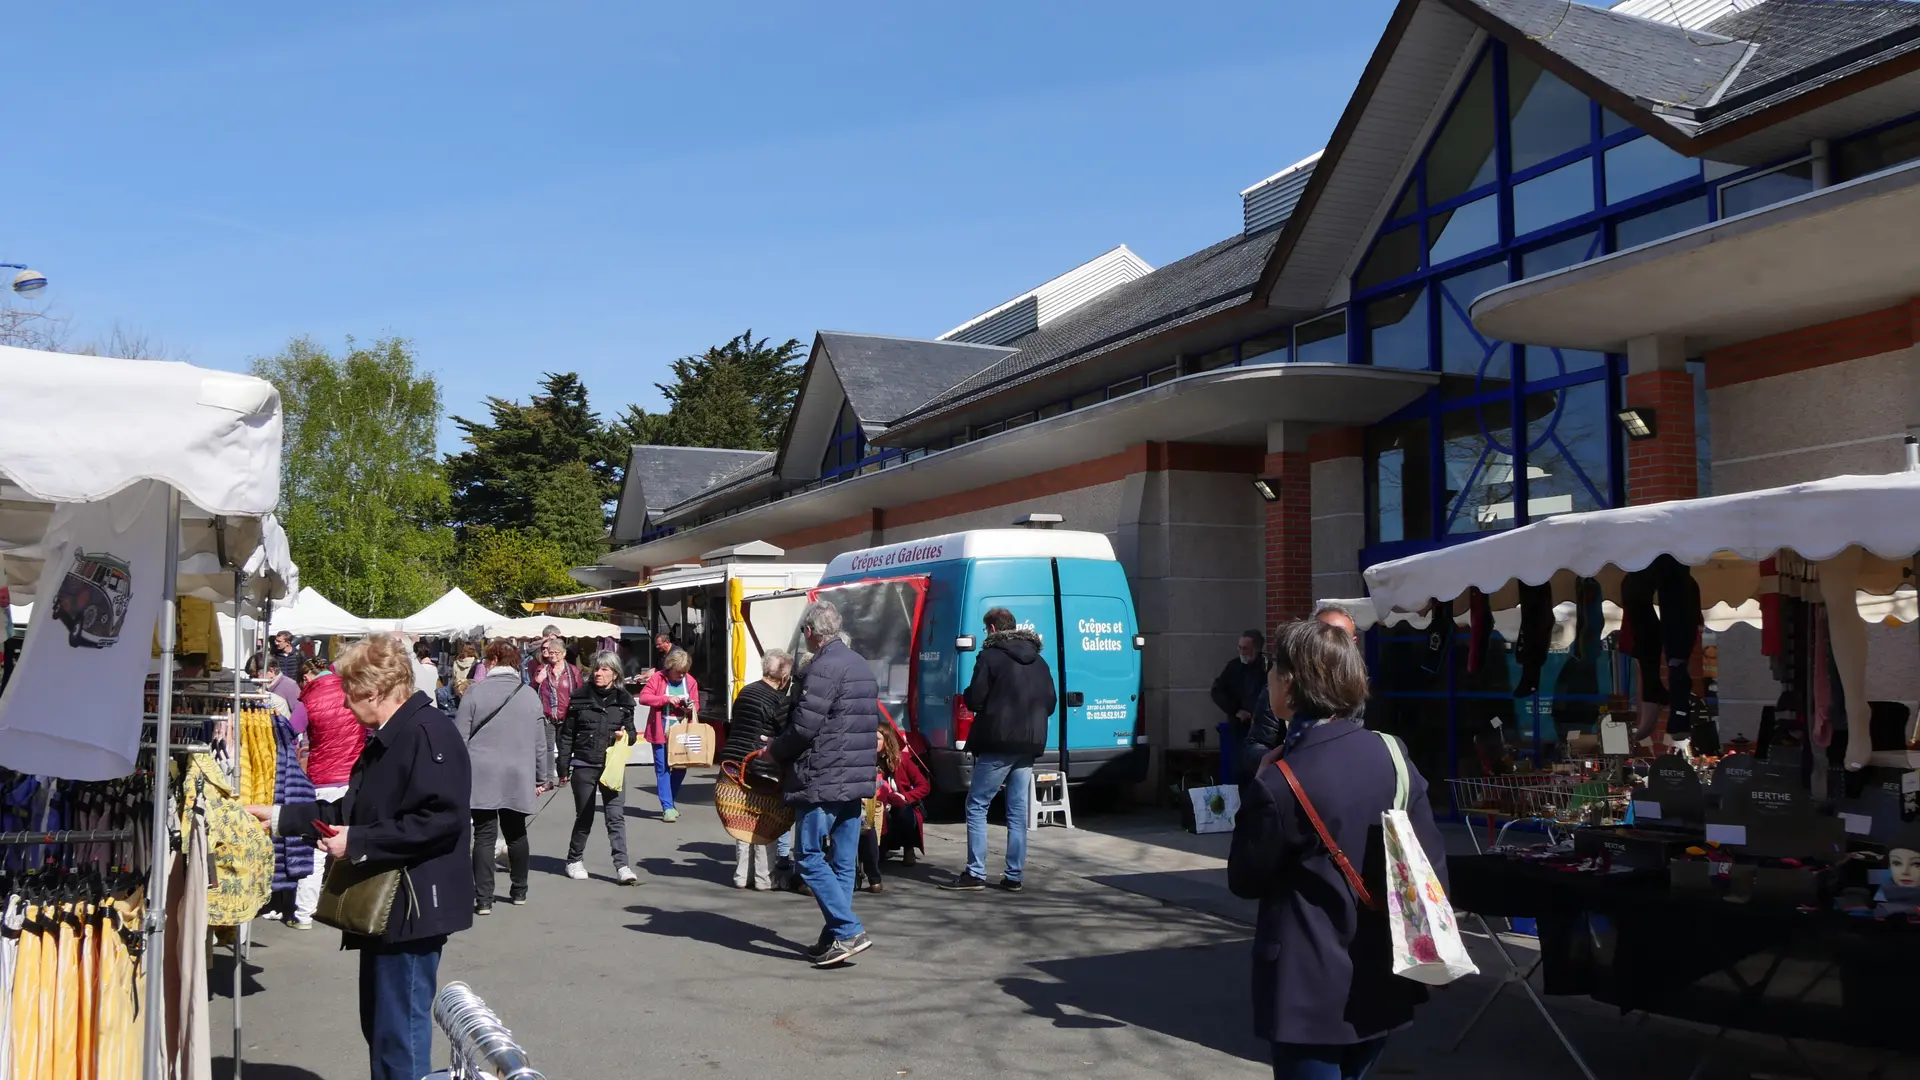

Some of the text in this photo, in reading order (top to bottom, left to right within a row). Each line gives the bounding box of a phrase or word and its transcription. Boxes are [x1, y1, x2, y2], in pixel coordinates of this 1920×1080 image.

[852, 545, 943, 572] Crêpes et Galettes
[1079, 618, 1123, 636] Crêpes et
[1082, 637, 1122, 651] Galettes
[1659, 769, 1686, 778] BERTHE
[1725, 767, 1753, 777] BERTHE
[1751, 791, 1792, 801] BERTHE
[1603, 841, 1626, 850] BERTHE
